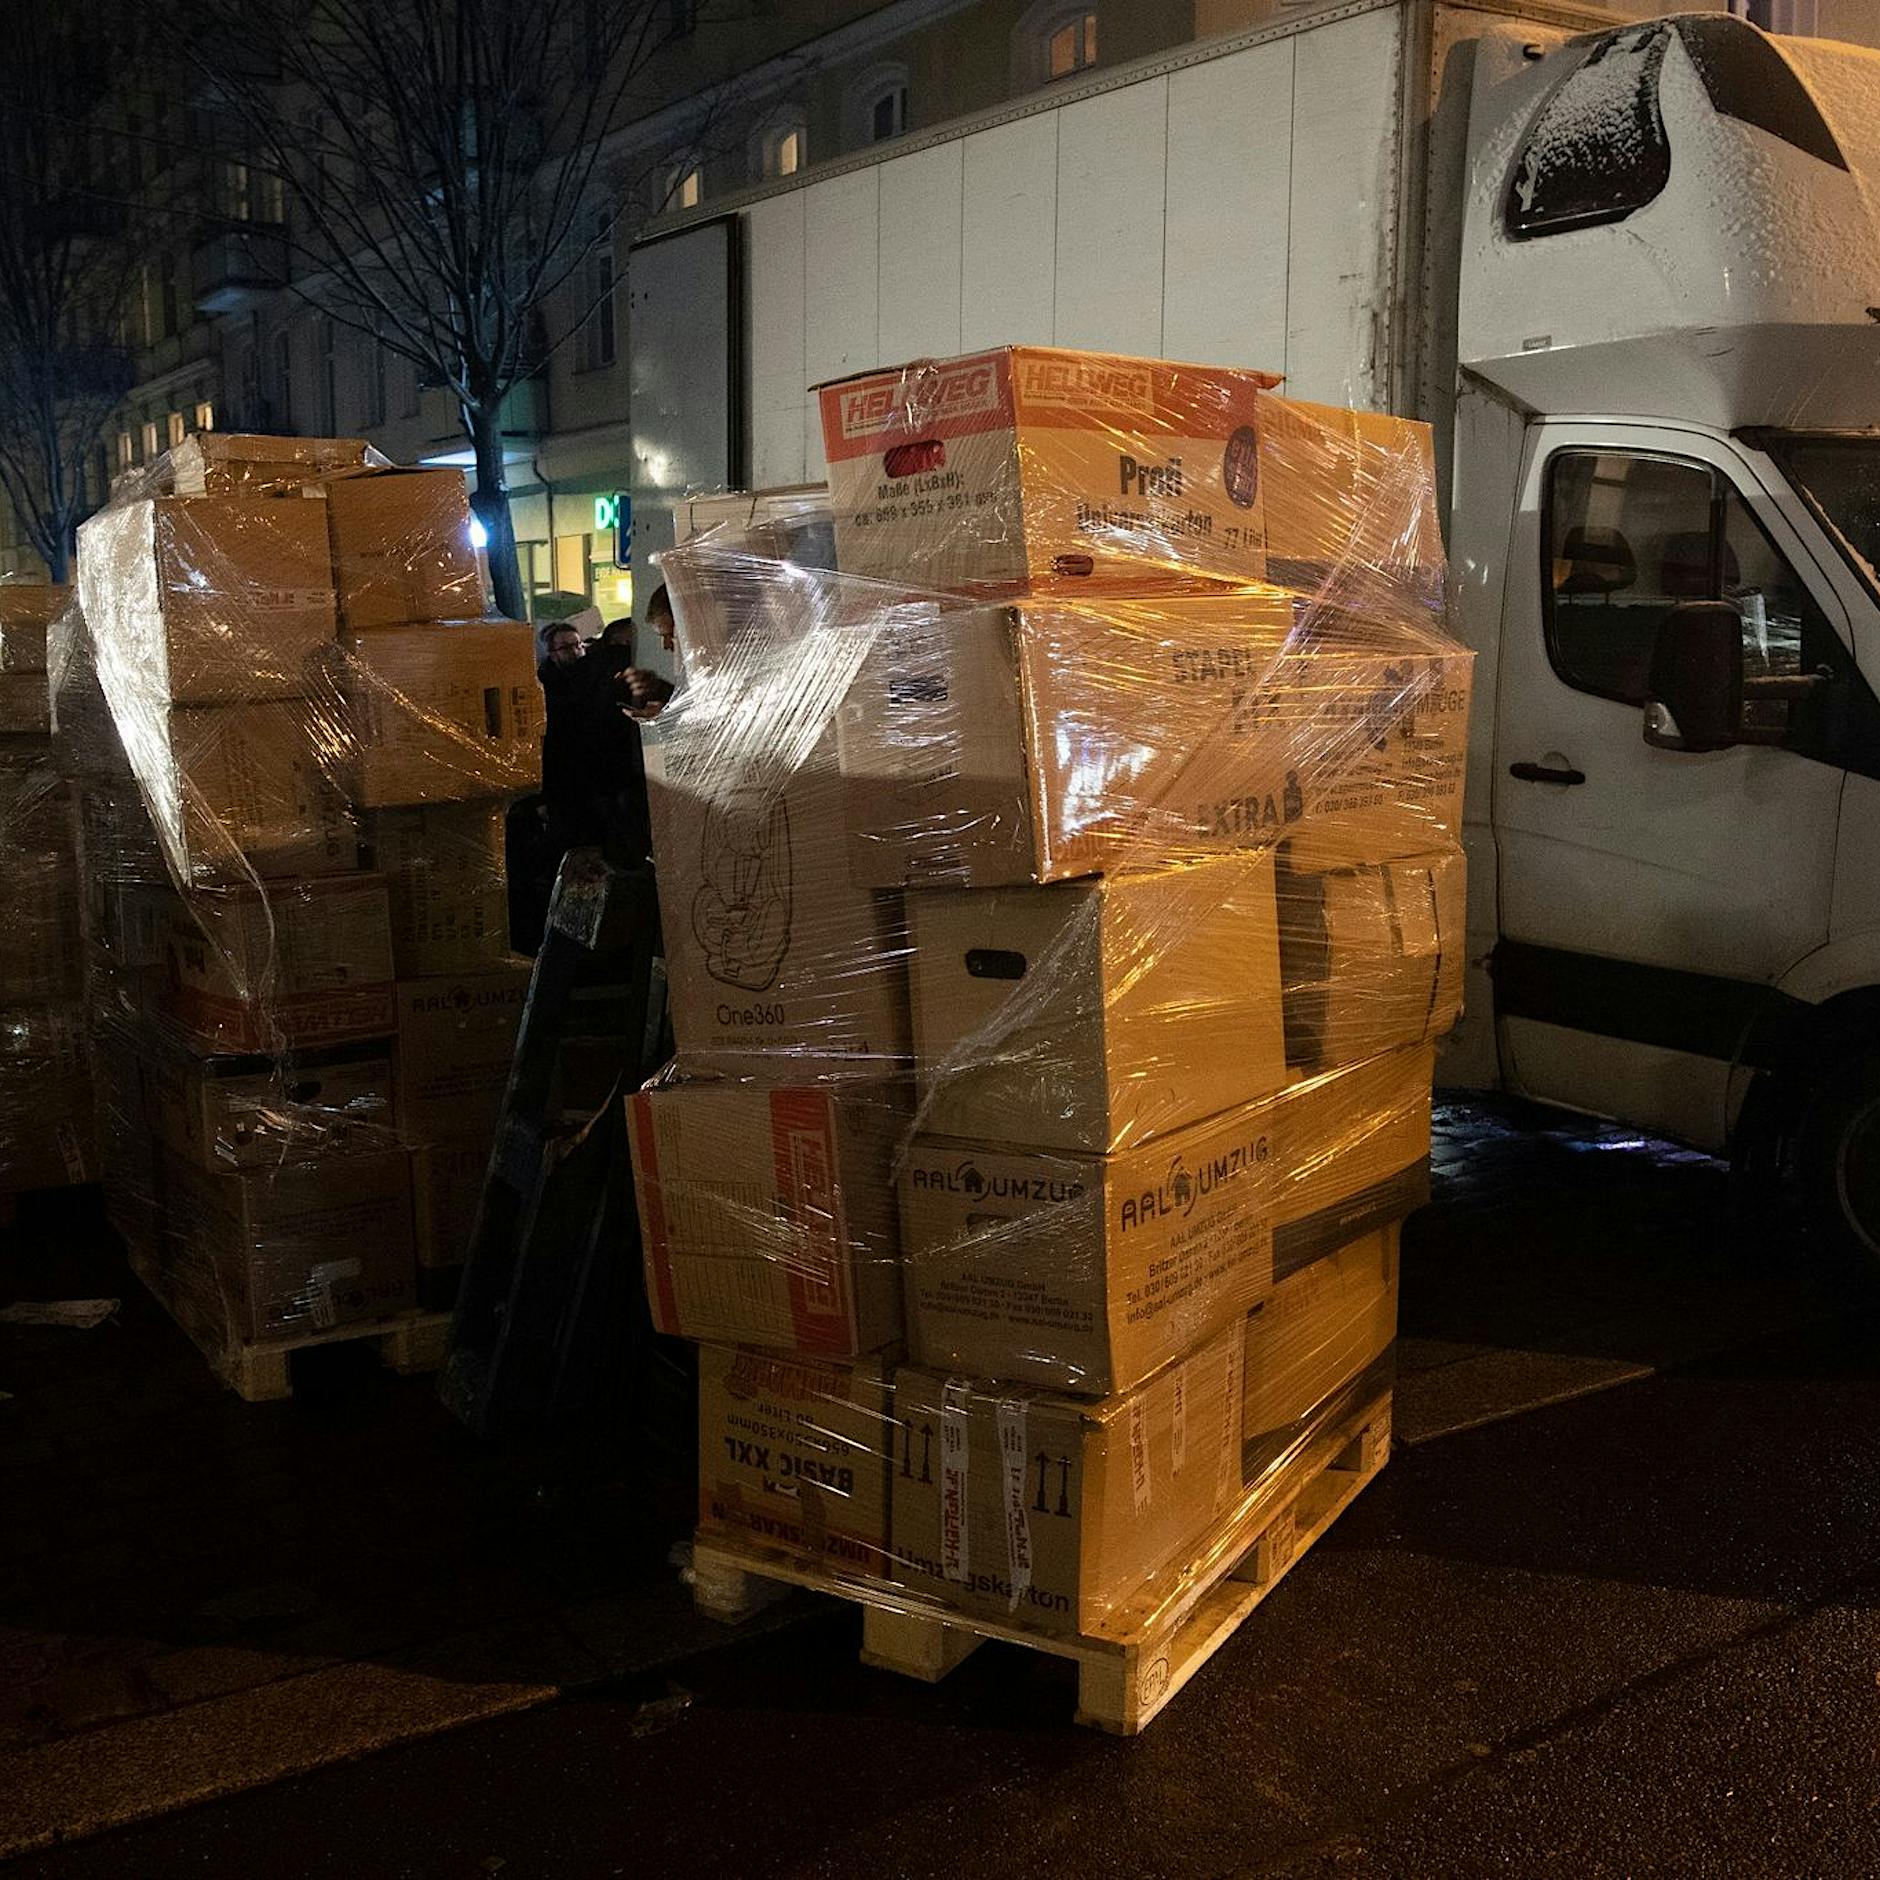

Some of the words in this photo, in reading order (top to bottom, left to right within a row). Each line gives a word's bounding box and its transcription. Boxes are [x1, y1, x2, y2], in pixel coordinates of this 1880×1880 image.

[847, 369, 991, 424] HELWEG
[878, 482, 910, 499] Maße
[716, 1003, 785, 1026] One360
[912, 1169, 961, 1192] AAL
[1121, 1187, 1171, 1232] AAL
[1197, 1135, 1270, 1196] UMZUG
[725, 1434, 770, 1471] XXL
[780, 1452, 854, 1491] BASIC
